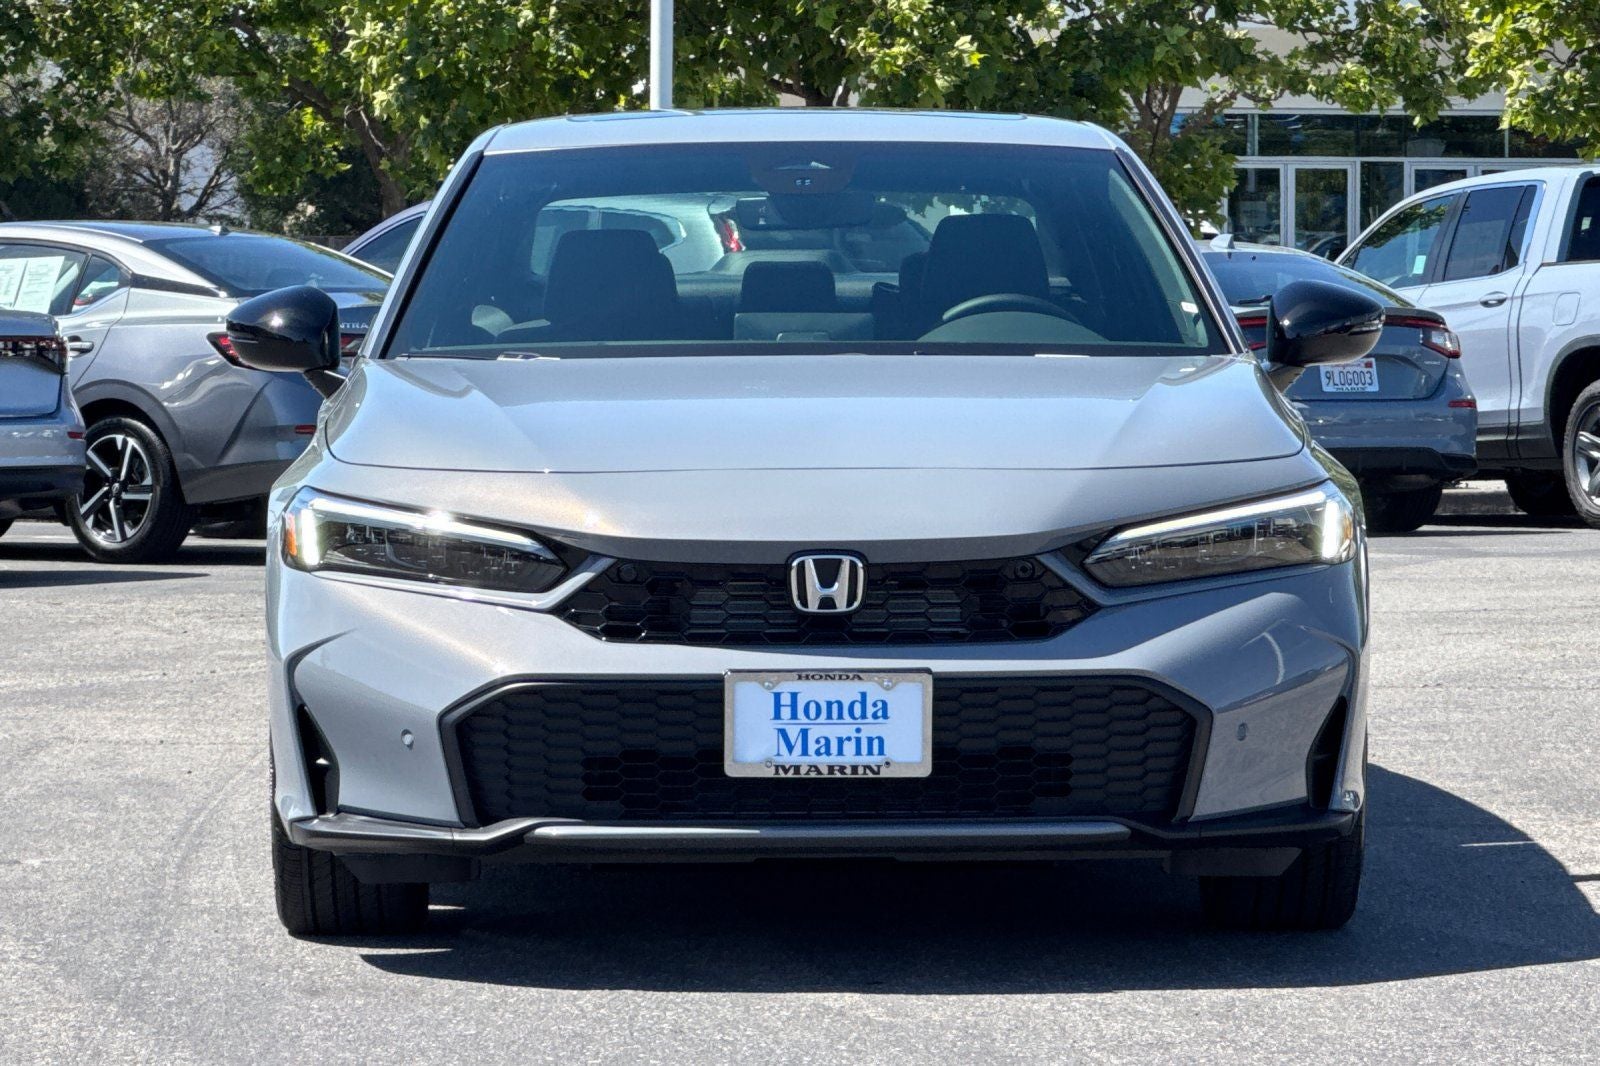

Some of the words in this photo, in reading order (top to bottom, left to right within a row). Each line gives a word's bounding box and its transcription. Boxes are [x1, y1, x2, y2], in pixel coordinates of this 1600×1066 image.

[796, 673, 864, 681] HONDA
[770, 691, 890, 721] Honda
[773, 727, 887, 757] Marin
[773, 764, 883, 776] MARIN
